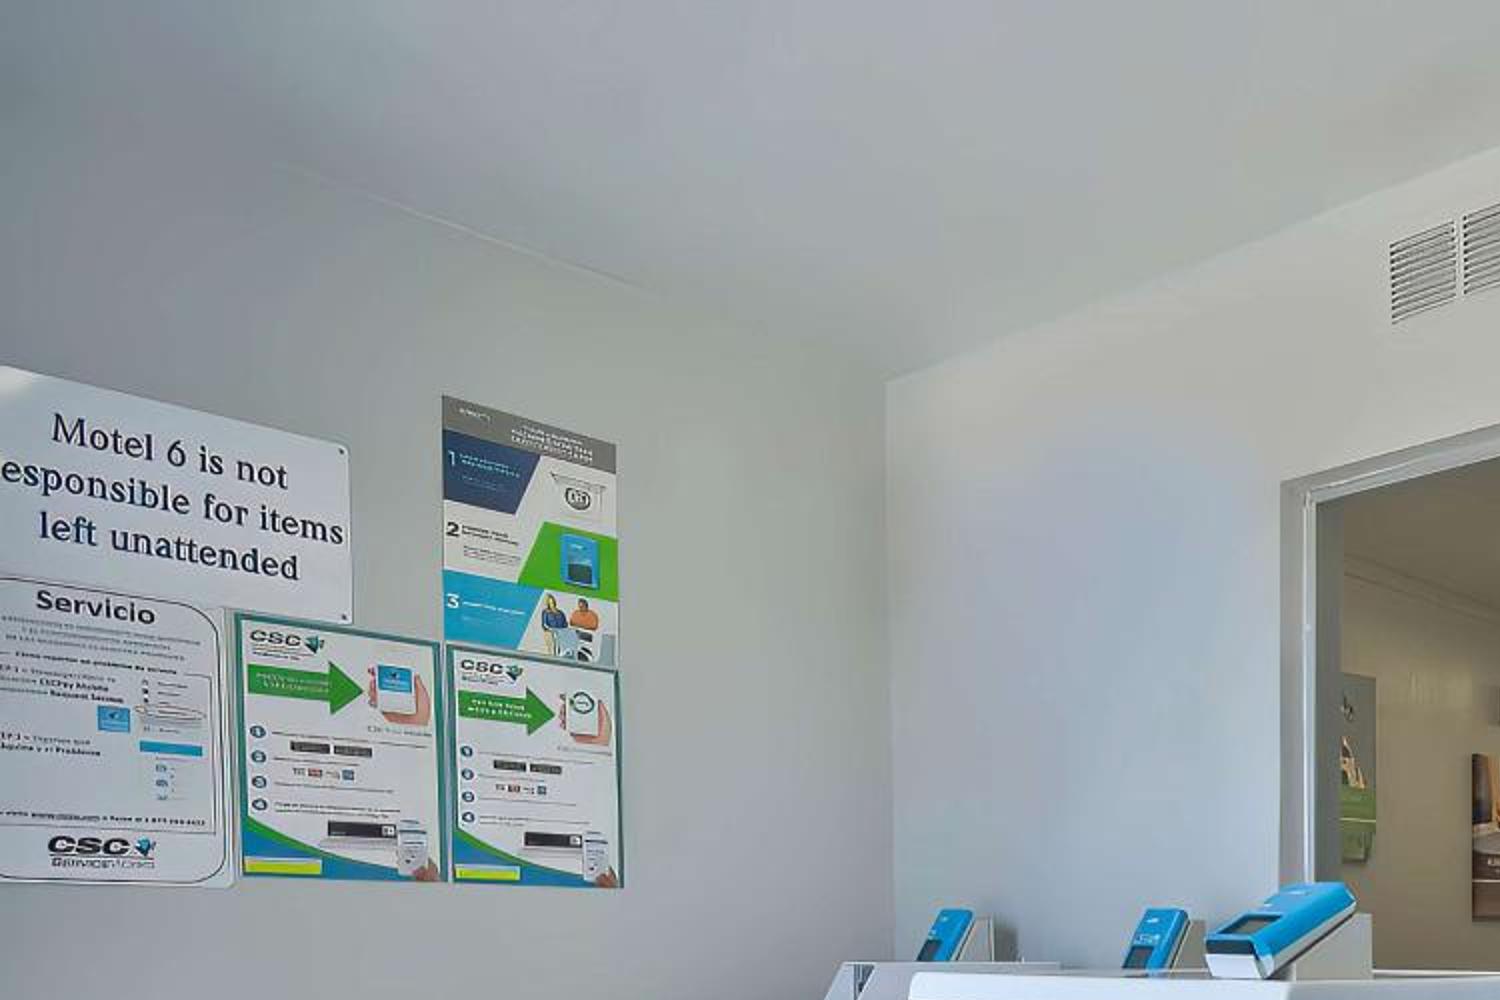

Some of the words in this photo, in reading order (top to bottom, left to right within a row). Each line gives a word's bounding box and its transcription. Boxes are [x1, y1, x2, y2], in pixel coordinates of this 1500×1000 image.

[51, 412, 154, 461] Motel
[166, 440, 188, 467] 6
[199, 445, 225, 476] is
[236, 459, 289, 490] not
[0, 460, 191, 515] esponsible
[203, 493, 250, 526] for
[259, 504, 345, 545] items
[446, 521, 461, 537] 2
[40, 511, 97, 547] left
[110, 529, 300, 581] unattended
[36, 589, 156, 625] Servicio
[446, 593, 461, 608] 3
[250, 629, 301, 647] CSC
[460, 658, 504, 676] CSC
[48, 835, 131, 855] CSC
